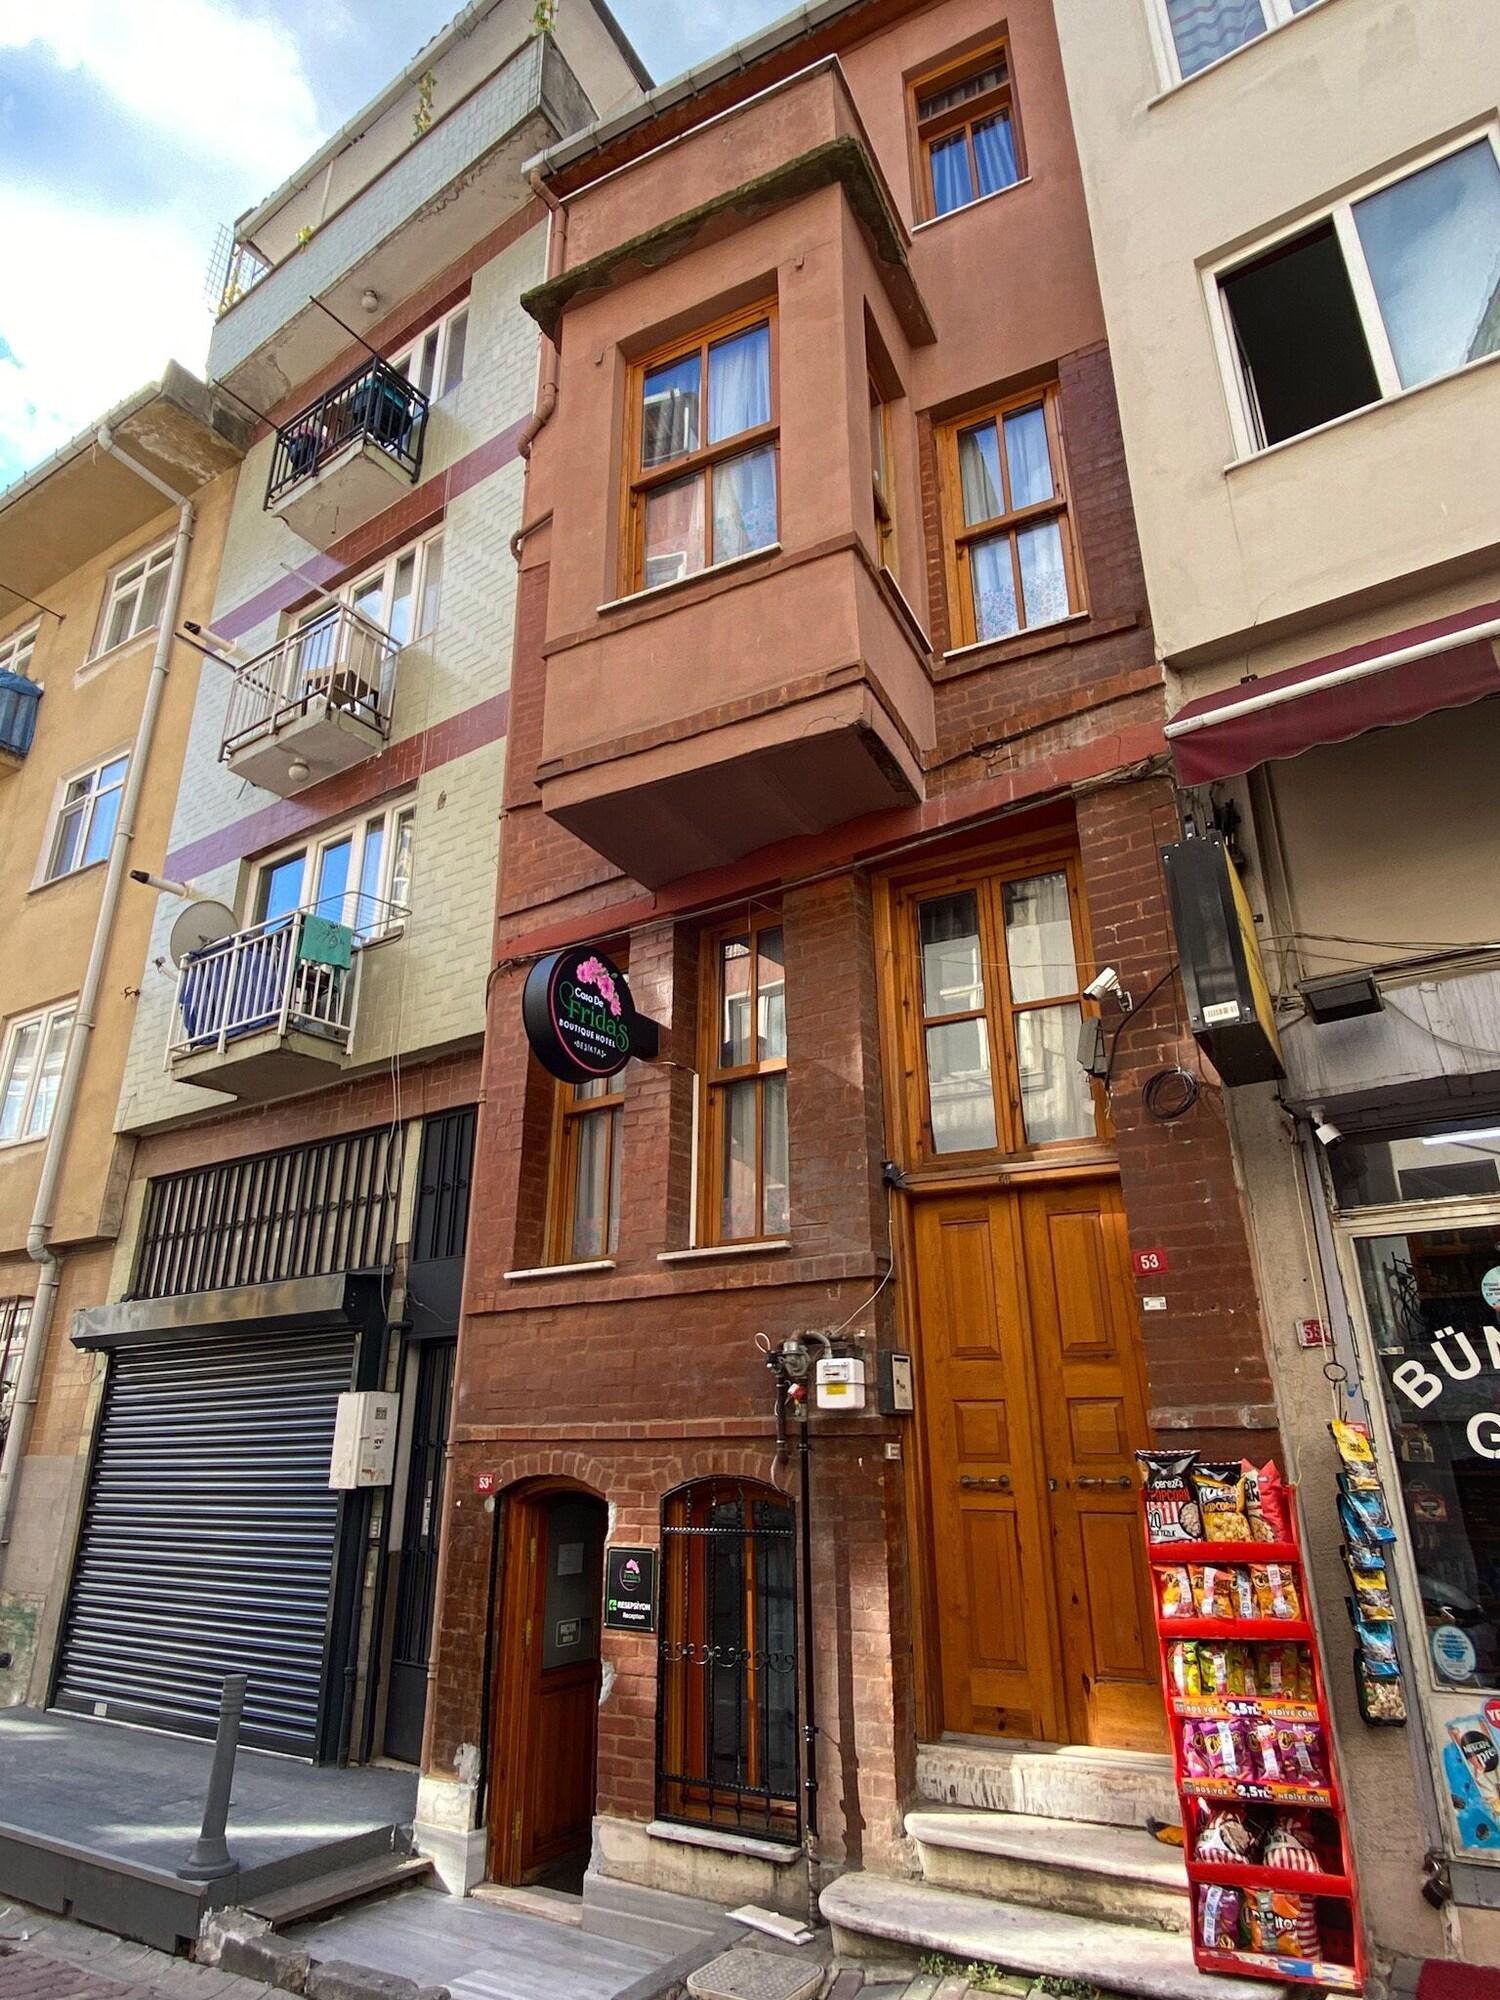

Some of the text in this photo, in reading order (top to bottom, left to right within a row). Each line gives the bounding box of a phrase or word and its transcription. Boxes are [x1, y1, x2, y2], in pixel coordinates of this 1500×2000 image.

[575, 987, 604, 1008] Casa De
[559, 981, 629, 1052] Frida's
[559, 1018, 616, 1048] BOUTIQUE HOTEL
[1140, 1253, 1159, 1269] 53
[1150, 1488, 1190, 1502] POPCORN
[1236, 1784, 1271, 1799] 2,5TL
